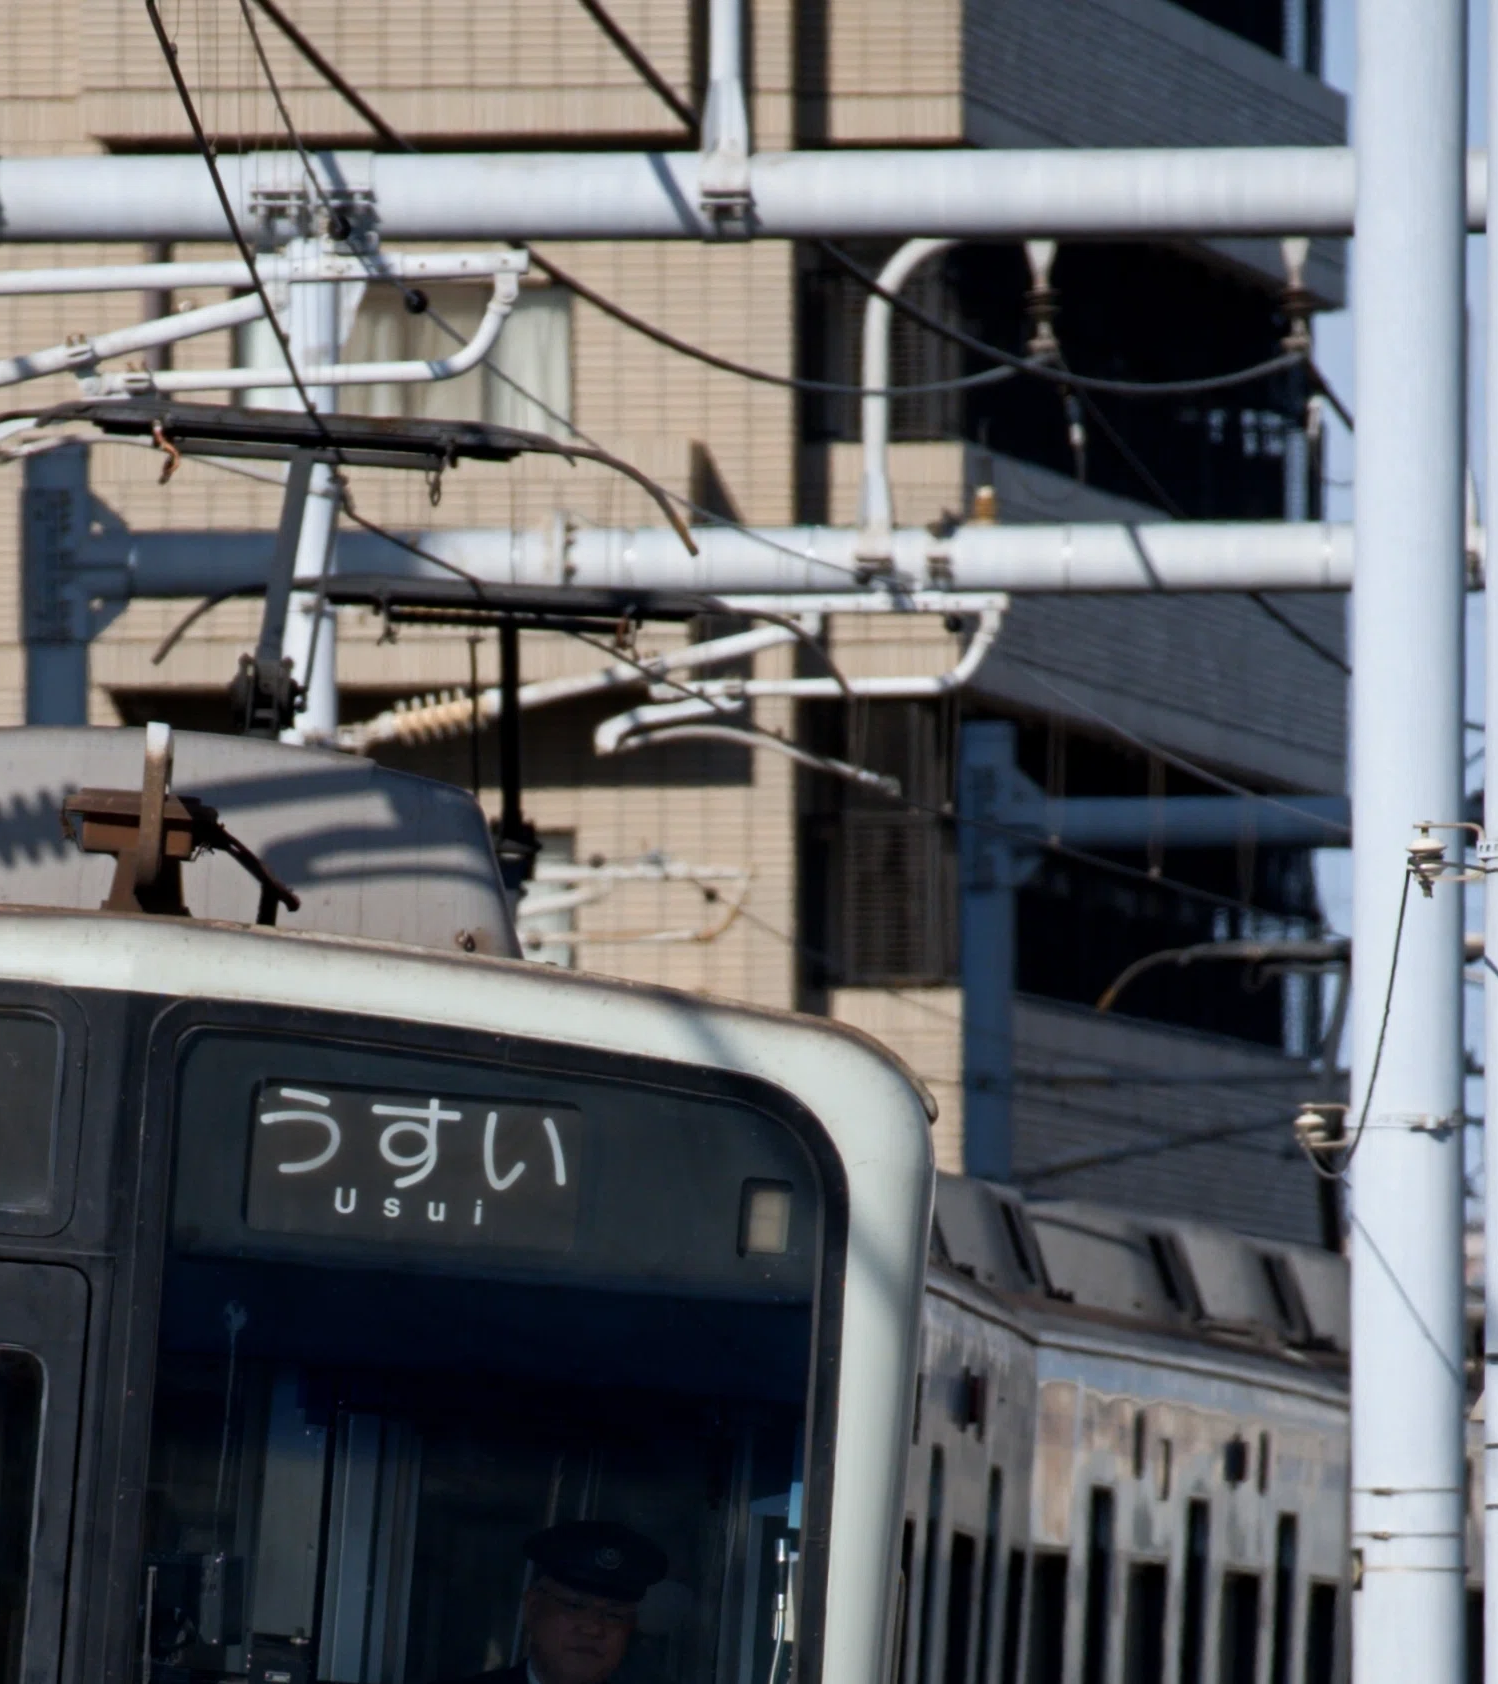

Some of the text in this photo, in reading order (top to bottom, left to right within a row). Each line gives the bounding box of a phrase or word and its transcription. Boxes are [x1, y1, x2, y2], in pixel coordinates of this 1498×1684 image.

[259, 1087, 567, 1191] うすい
[333, 1186, 484, 1226] Usui
